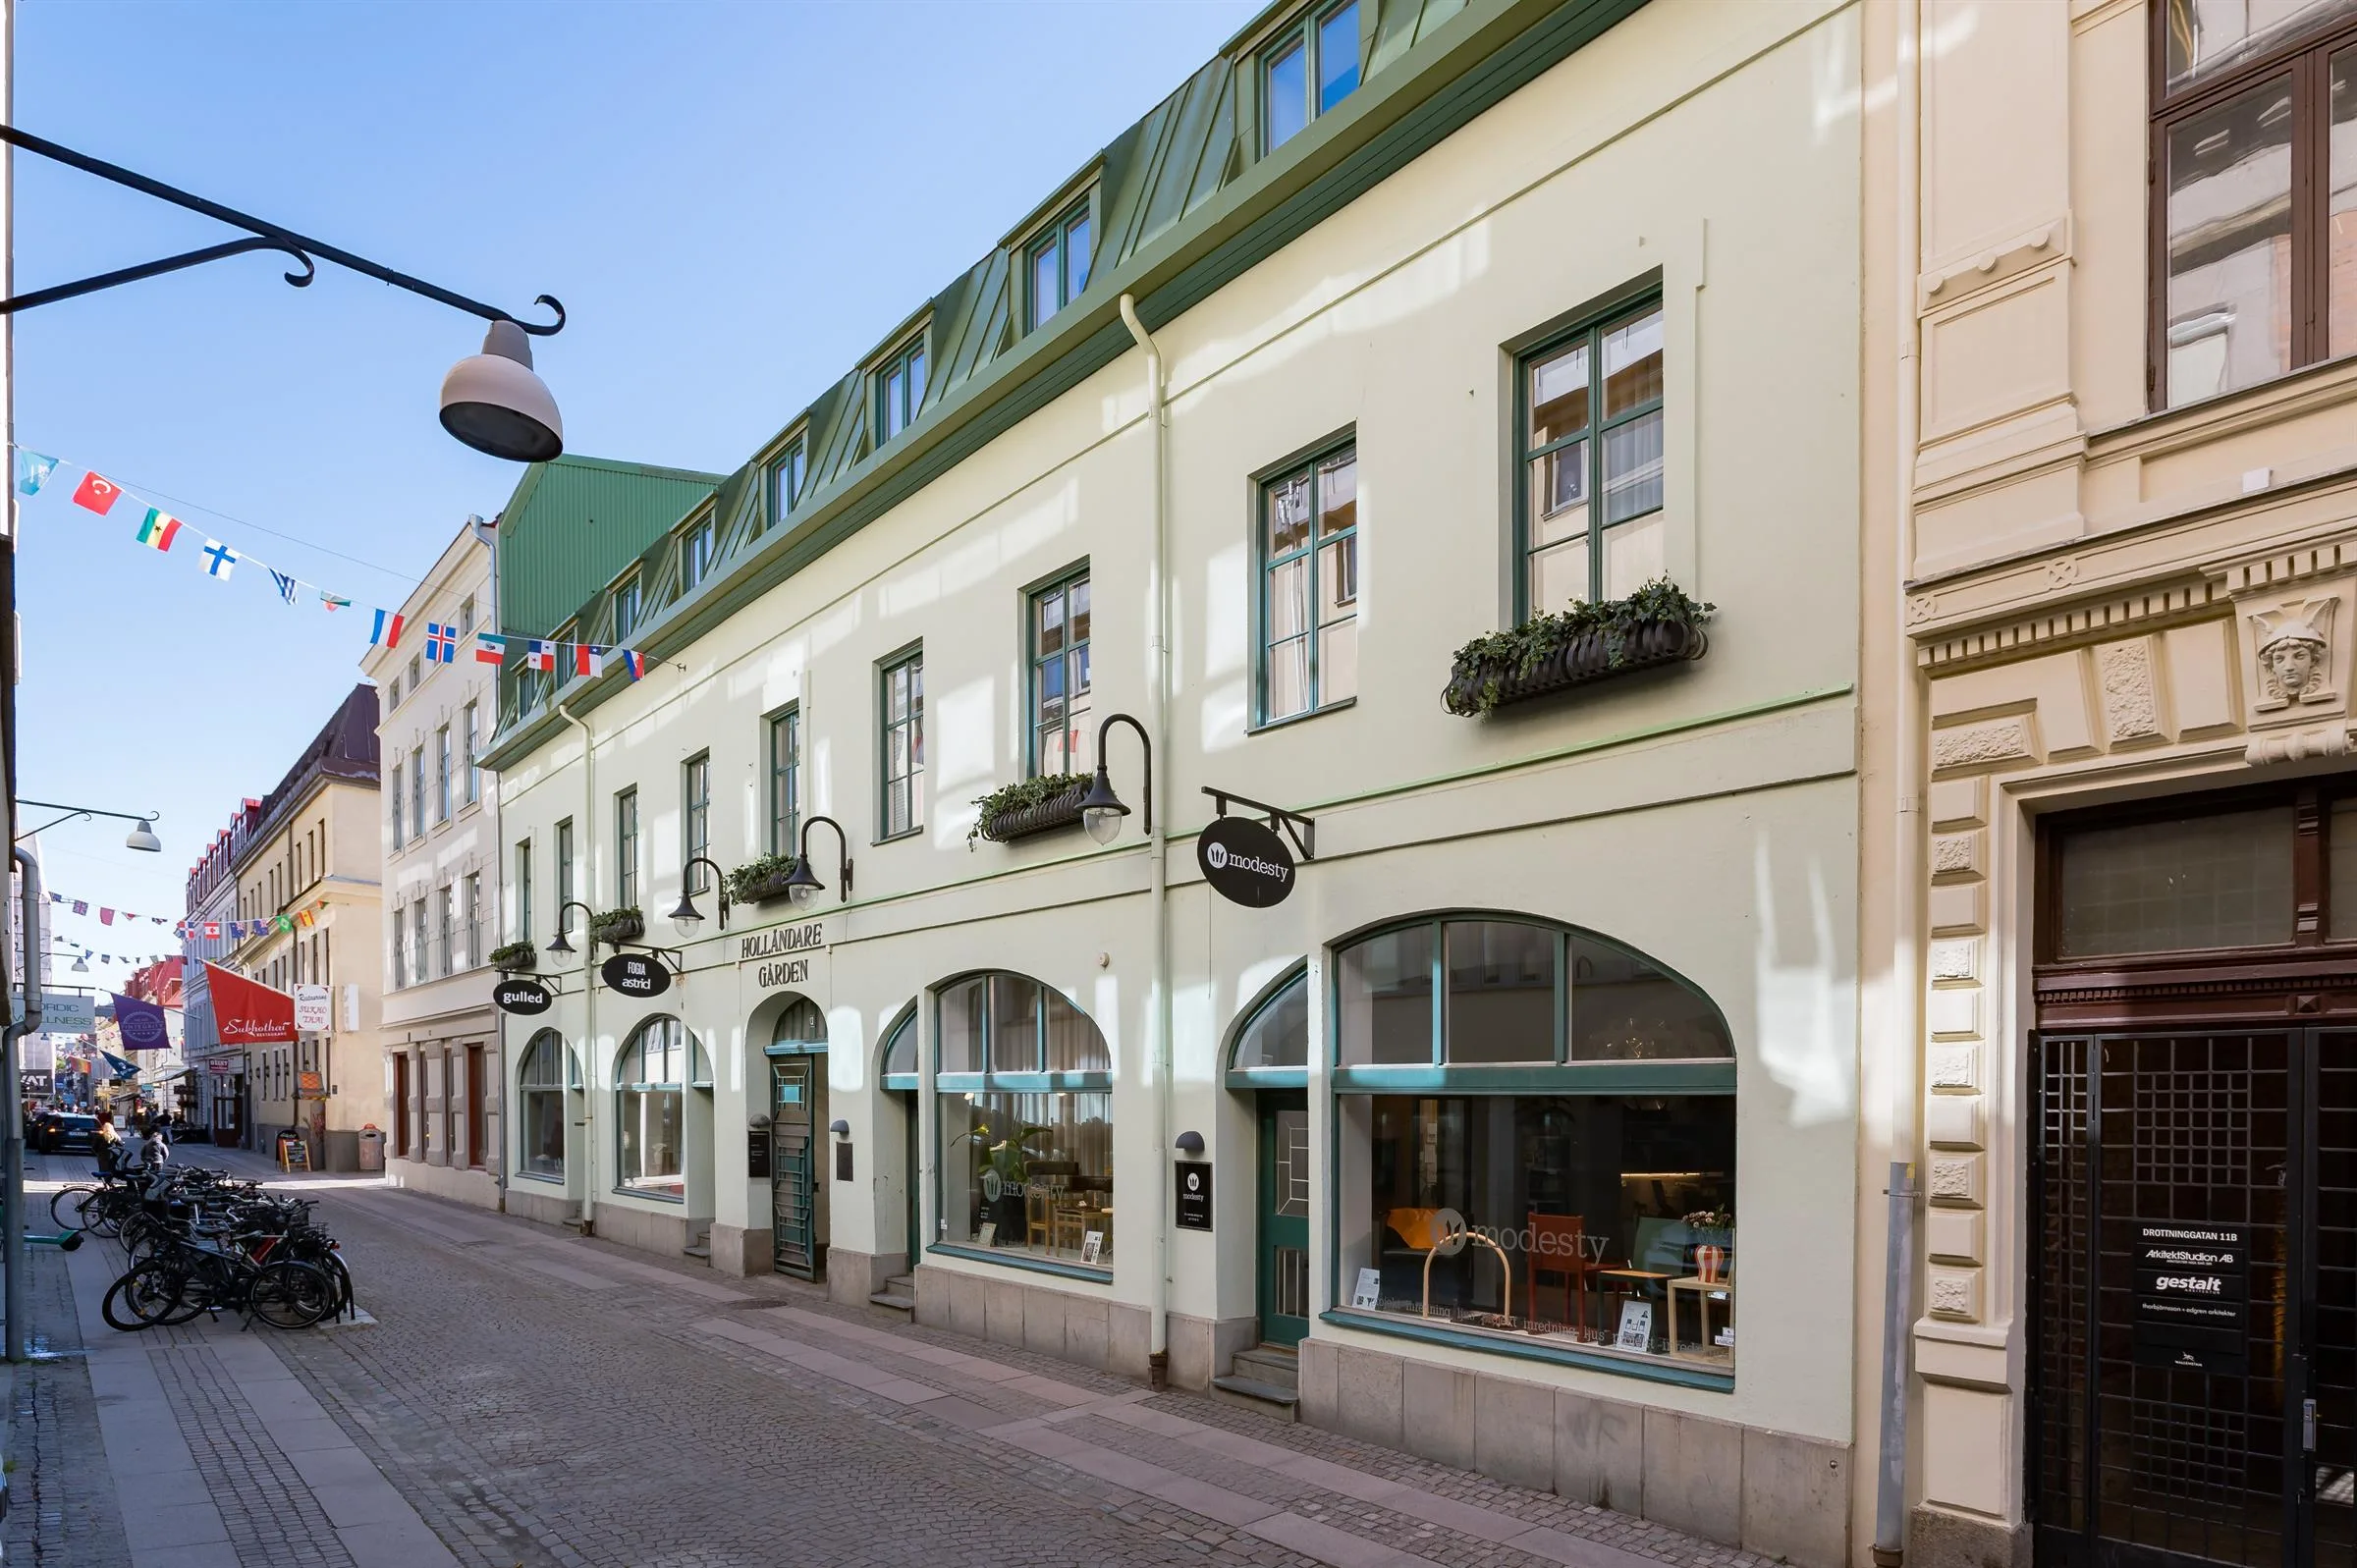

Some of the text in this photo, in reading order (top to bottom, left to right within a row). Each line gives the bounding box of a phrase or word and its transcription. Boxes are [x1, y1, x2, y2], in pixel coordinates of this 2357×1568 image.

[1229, 853, 1288, 882] modesty
[628, 961, 645, 975] FOGIA
[758, 959, 808, 988] GÅRDEN
[622, 977, 650, 990] astrid
[503, 991, 543, 1004] gulled
[40, 1003, 79, 1012] RDIC
[13, 1014, 92, 1025] WLNESS
[2142, 1228, 2218, 1240] DROTTNINGGATAN
[1471, 1221, 1610, 1267] modesty
[2146, 1249, 2233, 1263] ArkitektStudion AB
[2156, 1276, 2221, 1291] gestalt
[1583, 1325, 1605, 1342] ljus
